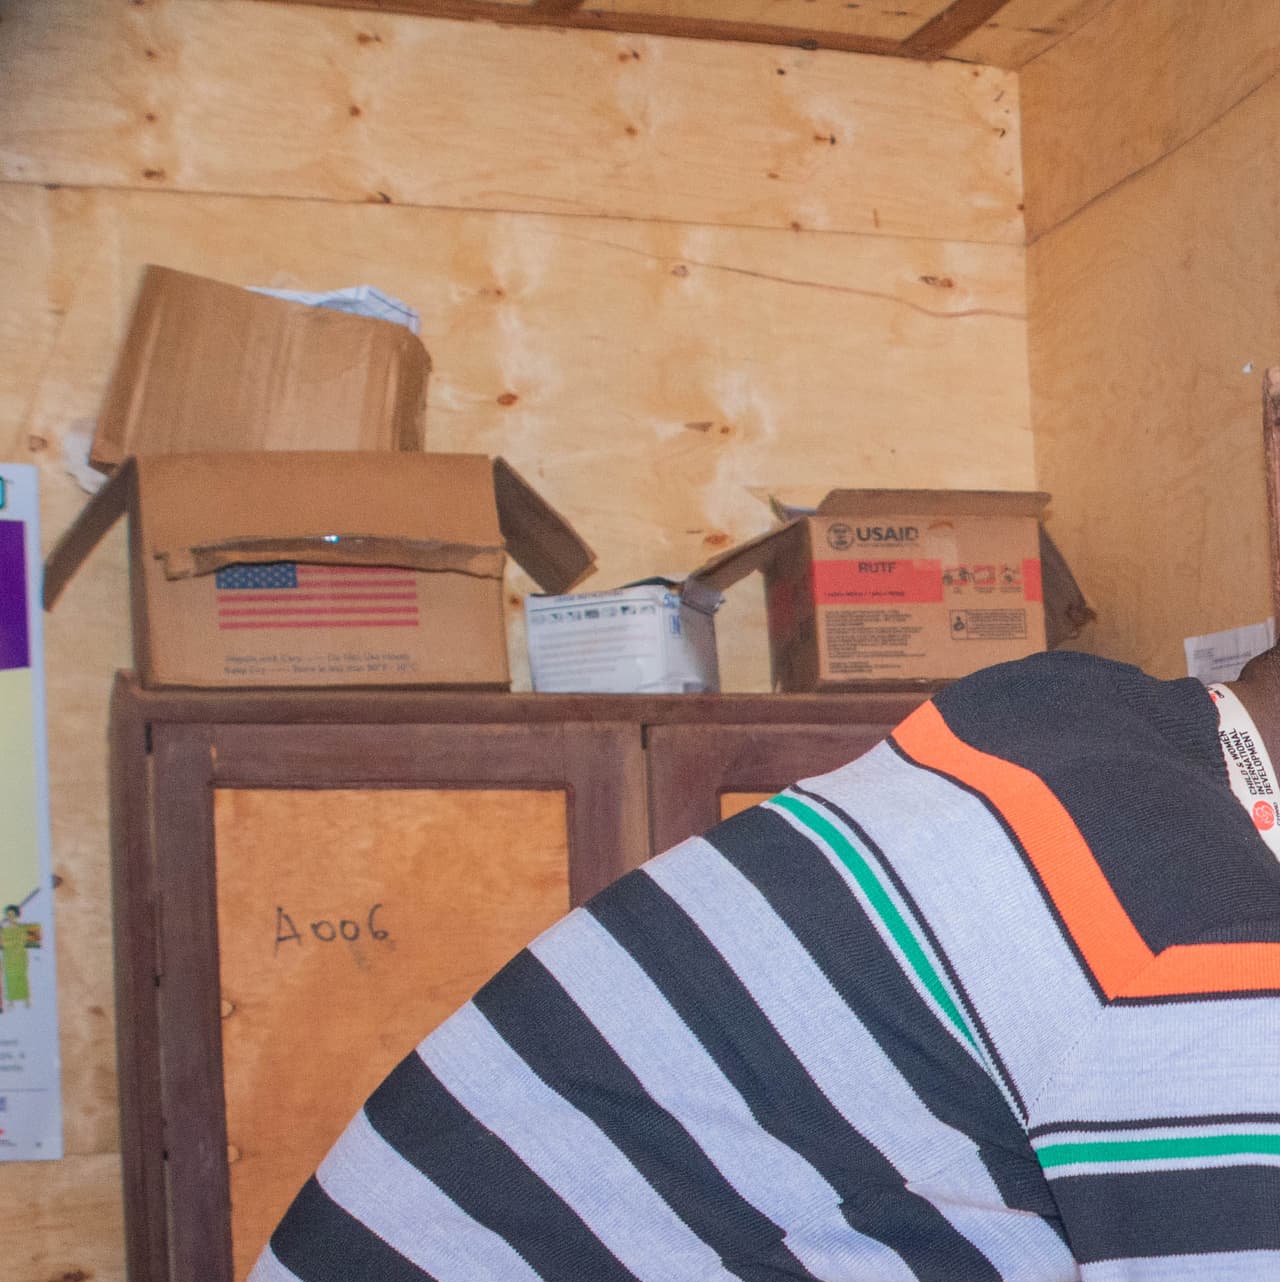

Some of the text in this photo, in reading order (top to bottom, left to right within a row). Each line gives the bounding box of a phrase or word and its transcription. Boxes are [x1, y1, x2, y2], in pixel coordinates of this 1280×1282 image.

[855, 526, 920, 542] USAID
[858, 562, 897, 574] RUTF
[1218, 730, 1239, 761] WOMEN
[1229, 728, 1265, 796] INTERNATIONAL
[1239, 730, 1274, 795] DEVELOPMENT
